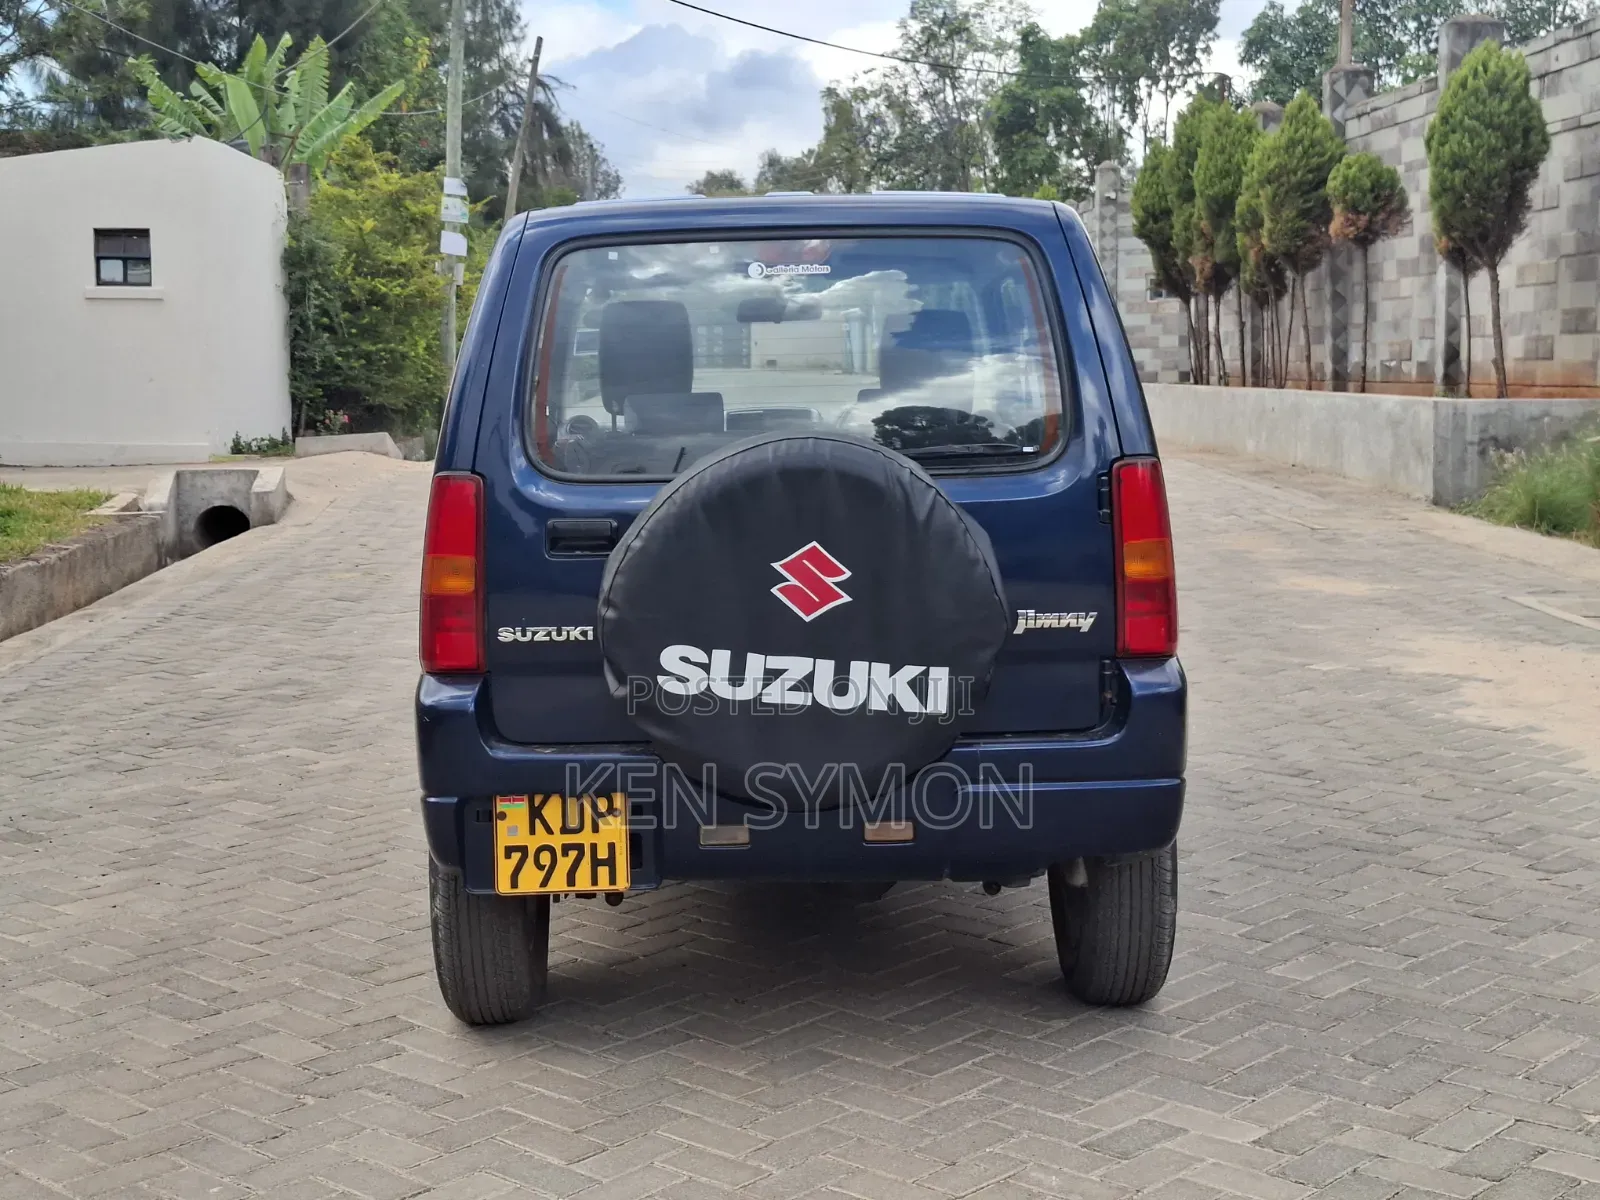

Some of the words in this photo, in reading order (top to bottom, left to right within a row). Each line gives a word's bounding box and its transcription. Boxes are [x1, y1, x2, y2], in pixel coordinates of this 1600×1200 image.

[765, 265, 799, 274] Galleria
[801, 265, 829, 273] Motors
[497, 626, 594, 642] SUZUKI
[656, 644, 950, 714] SUZUKI
[504, 841, 617, 889] 797H
